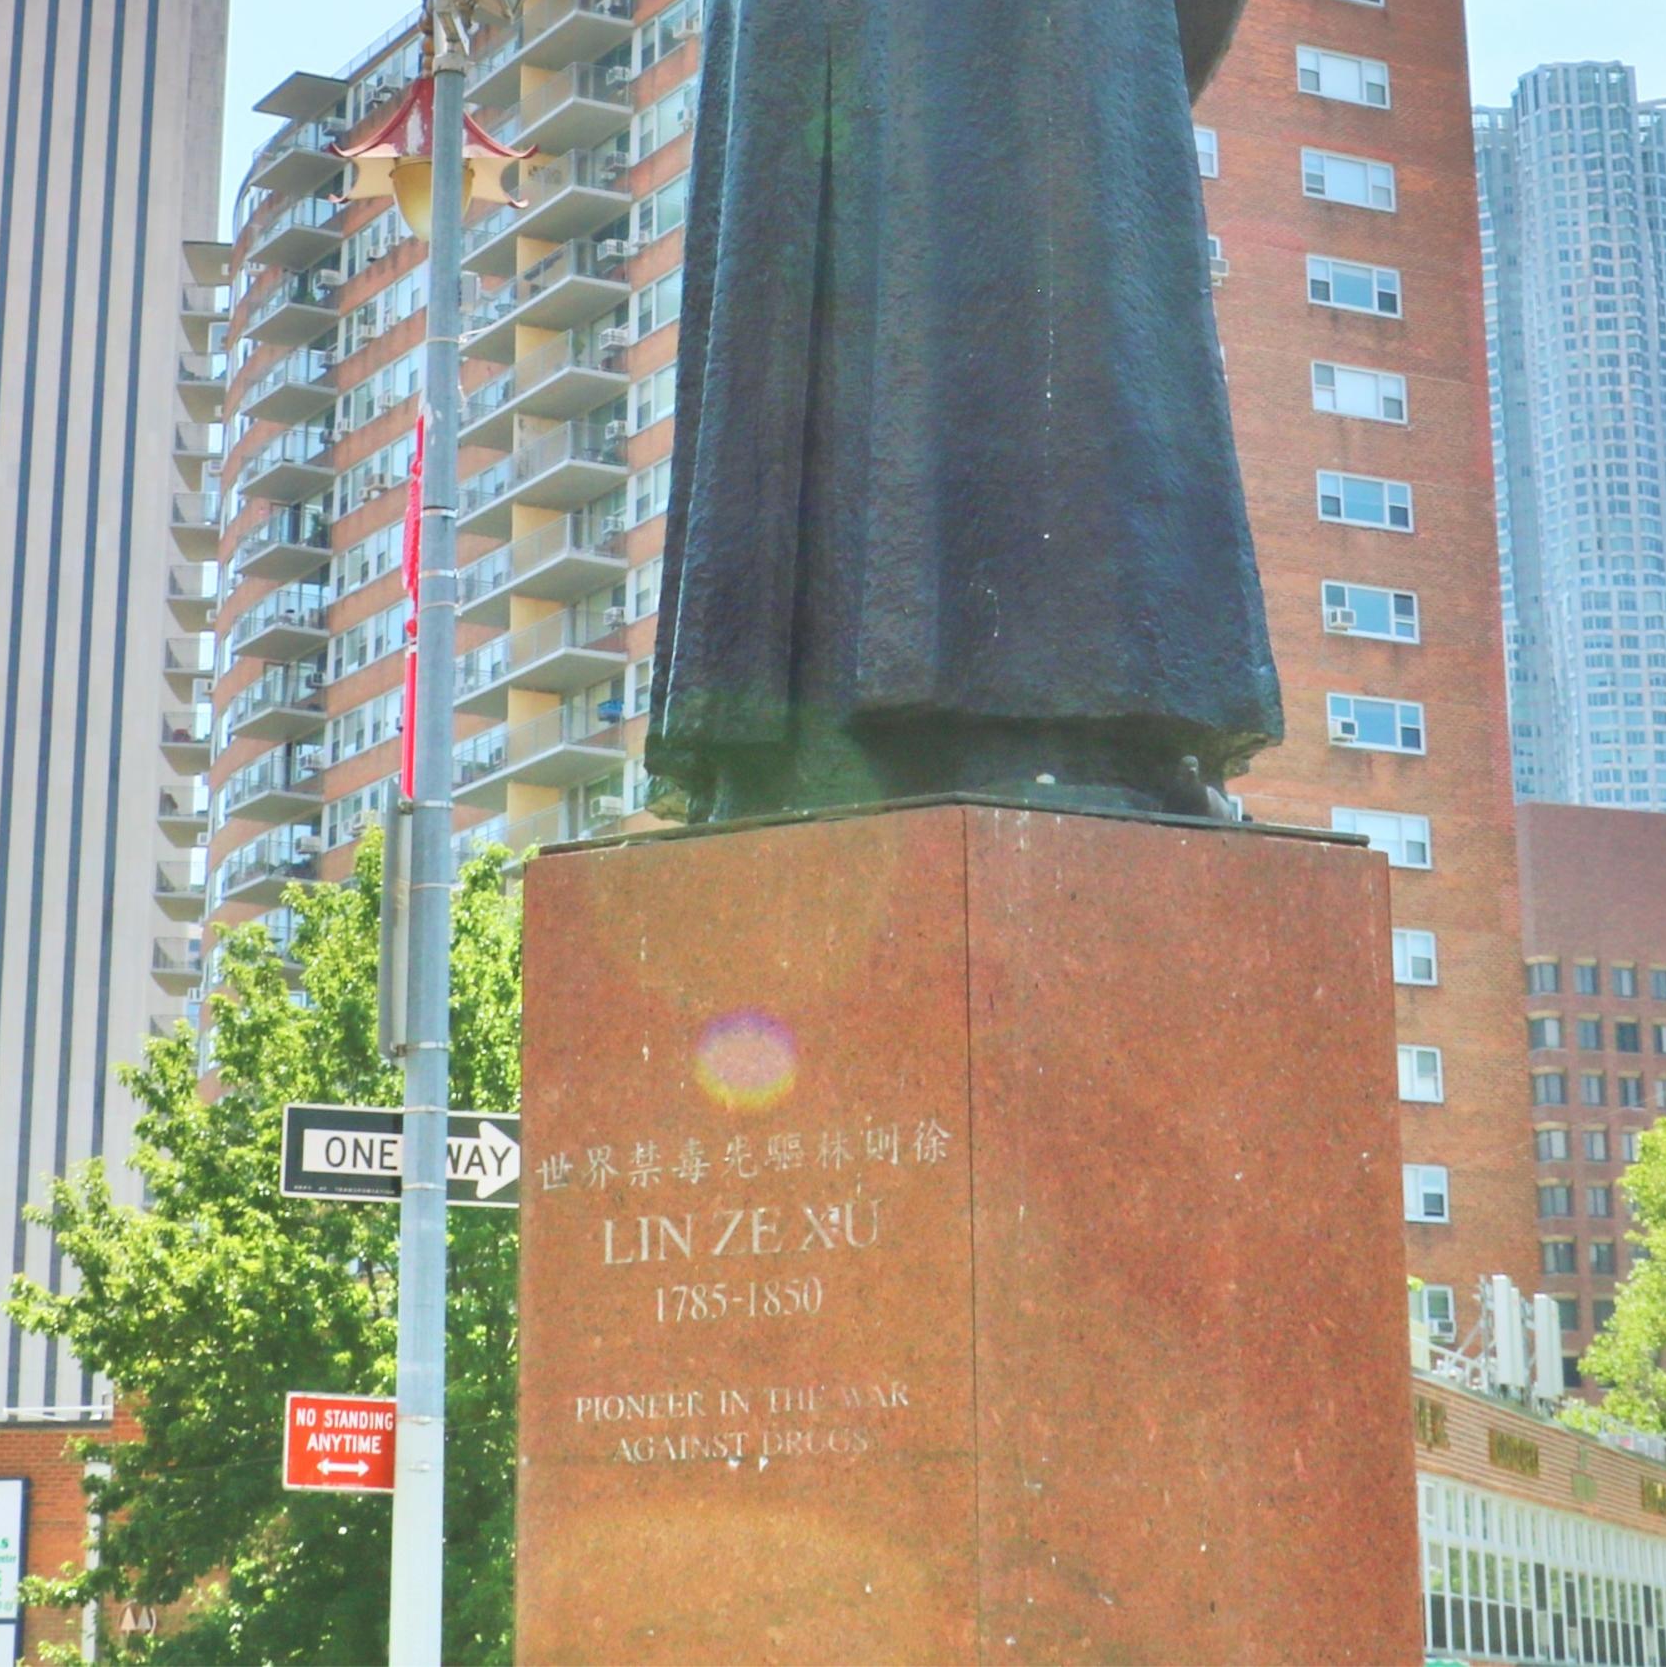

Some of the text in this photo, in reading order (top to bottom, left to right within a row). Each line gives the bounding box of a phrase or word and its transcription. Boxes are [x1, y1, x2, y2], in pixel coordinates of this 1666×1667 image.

[325, 1136, 398, 1171] ONE
[535, 1119, 953, 1191] 世界禁毒先驅林則徐
[602, 1199, 883, 1265] LIN ZE XU
[655, 1276, 824, 1323] 1785-1850
[296, 1408, 394, 1431] NO STANDING
[575, 1381, 909, 1423] PIONEER IN THE WAR
[306, 1433, 382, 1454] ANYTIME
[613, 1428, 869, 1463] AGAINST DRUGS
